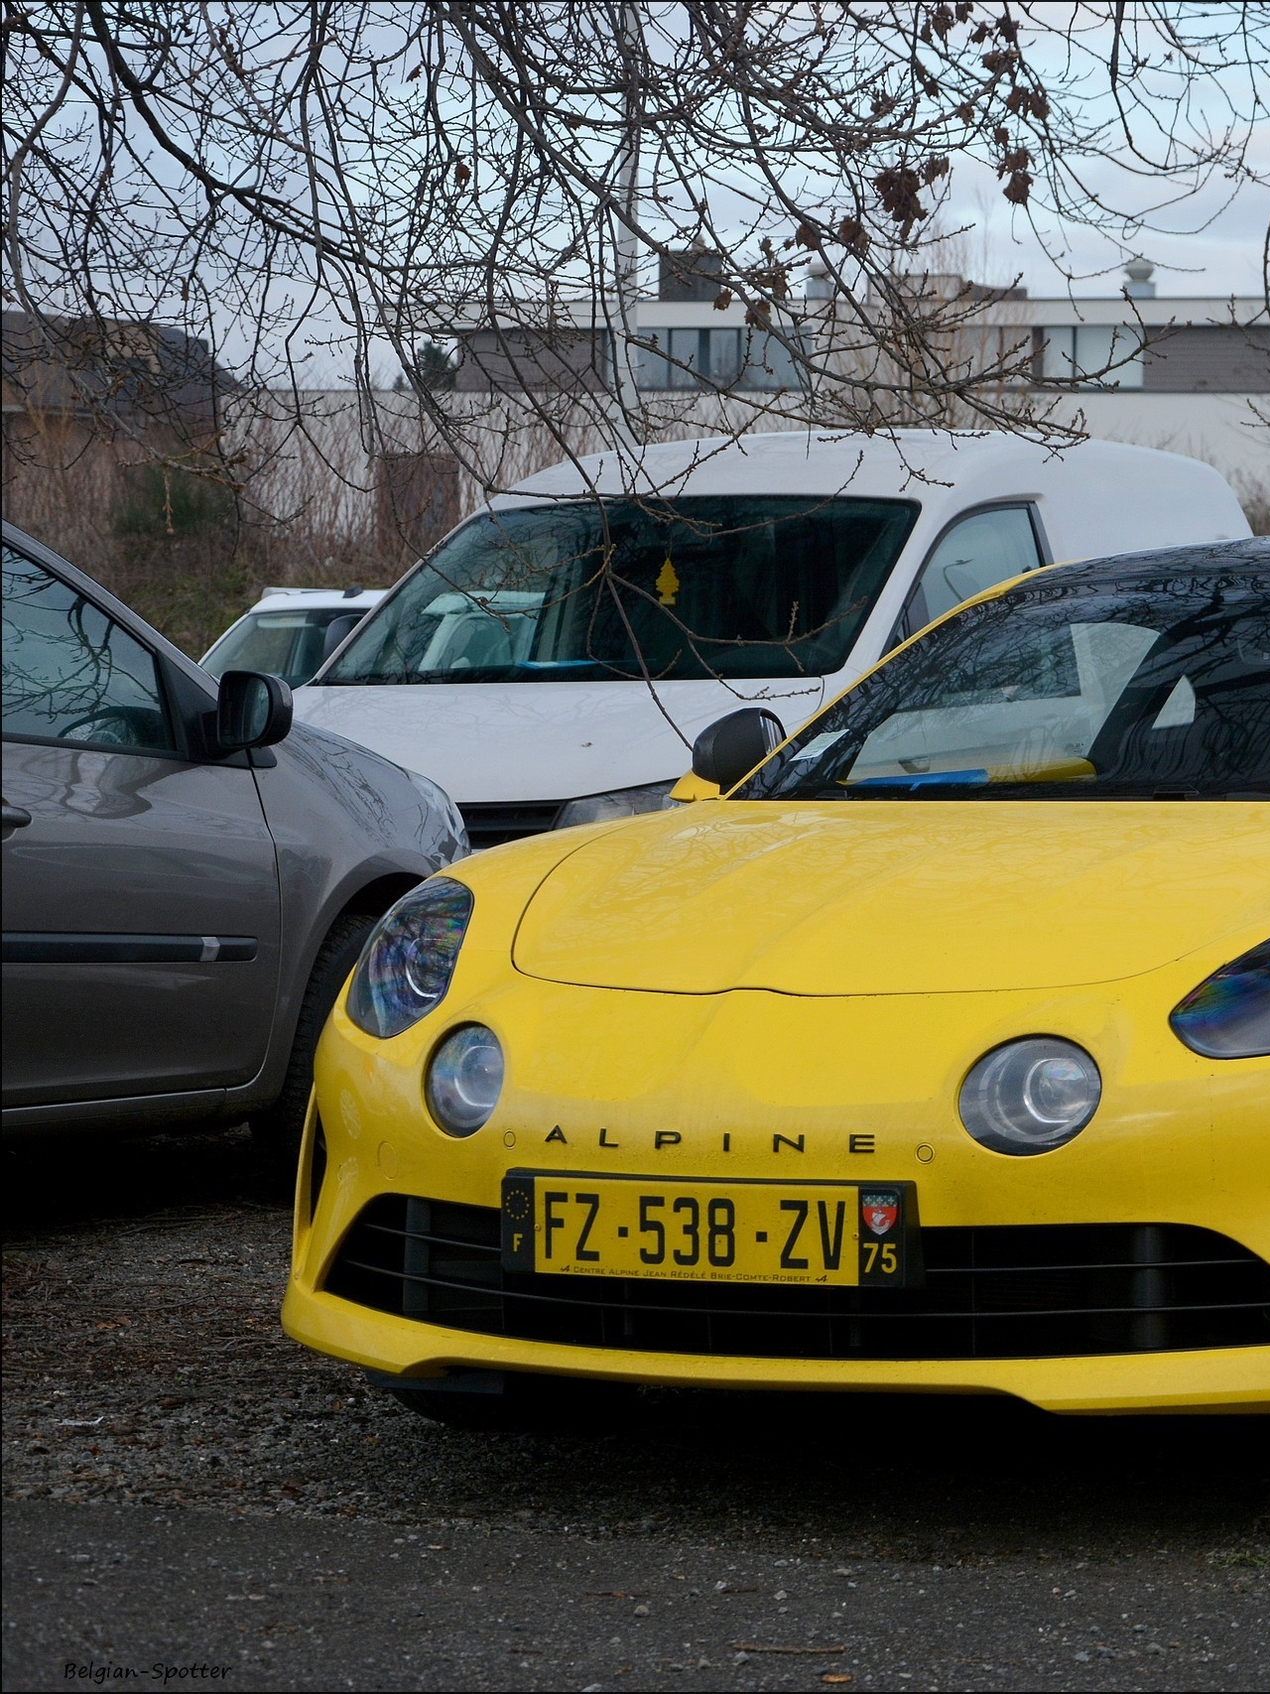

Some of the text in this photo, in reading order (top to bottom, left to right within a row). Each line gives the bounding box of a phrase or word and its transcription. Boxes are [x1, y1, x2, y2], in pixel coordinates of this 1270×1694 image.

[544, 1124, 876, 1154] ALPINE
[513, 1233, 524, 1252] F
[544, 1191, 846, 1271] FZ-538-ZV
[863, 1242, 898, 1274] 75
